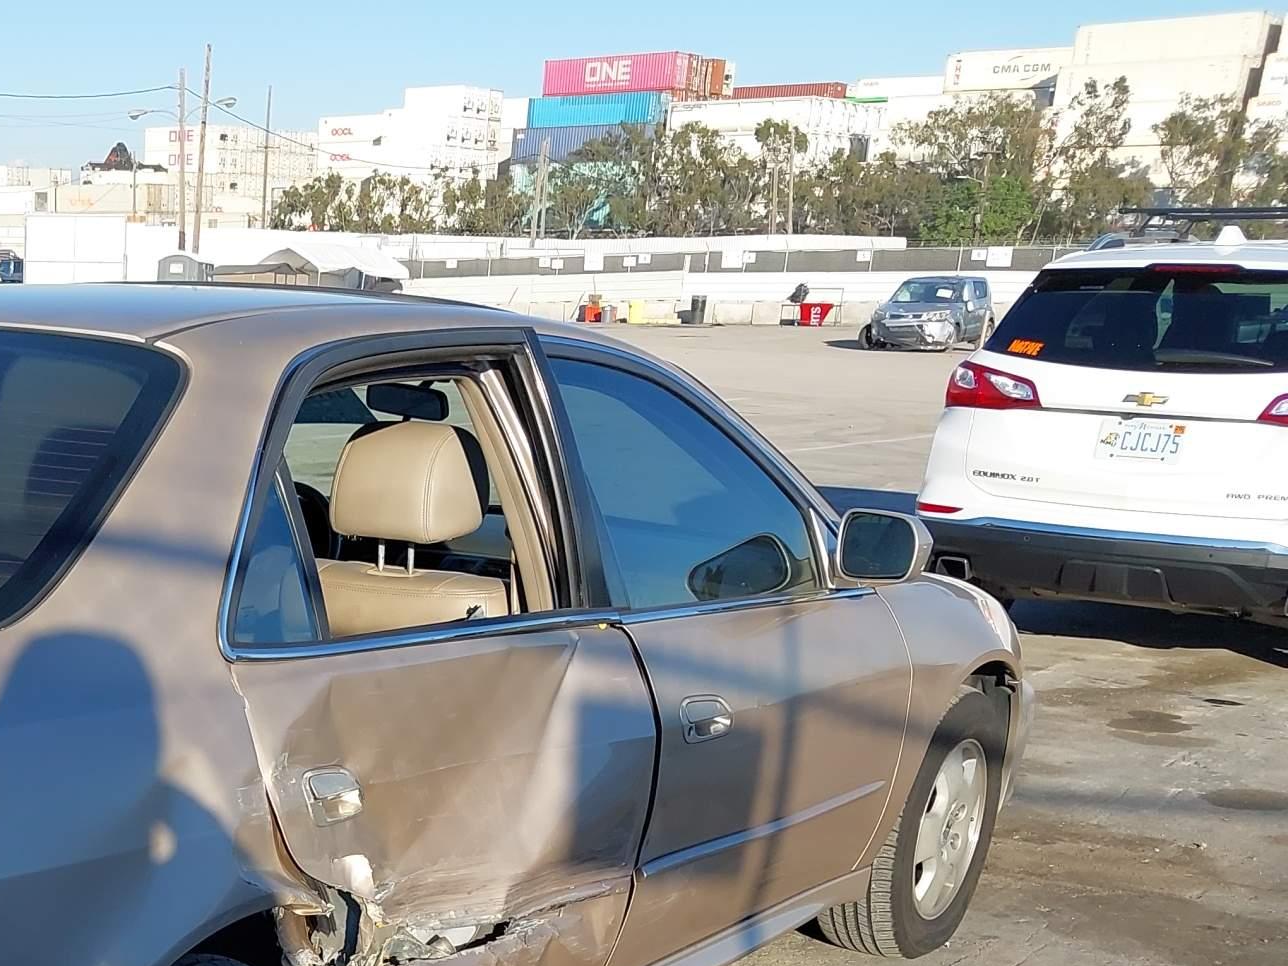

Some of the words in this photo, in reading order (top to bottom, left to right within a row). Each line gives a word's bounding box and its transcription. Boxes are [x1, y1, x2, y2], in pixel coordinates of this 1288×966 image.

[584, 60, 632, 82] ONE
[993, 64, 1020, 74] CMA
[1023, 63, 1051, 73] CGM
[168, 153, 193, 166] OE
[1007, 339, 1045, 356] NATIVE
[1120, 431, 1181, 454] CJCJ75
[972, 469, 1017, 481] EQUINOX
[1225, 493, 1251, 501] AWD
